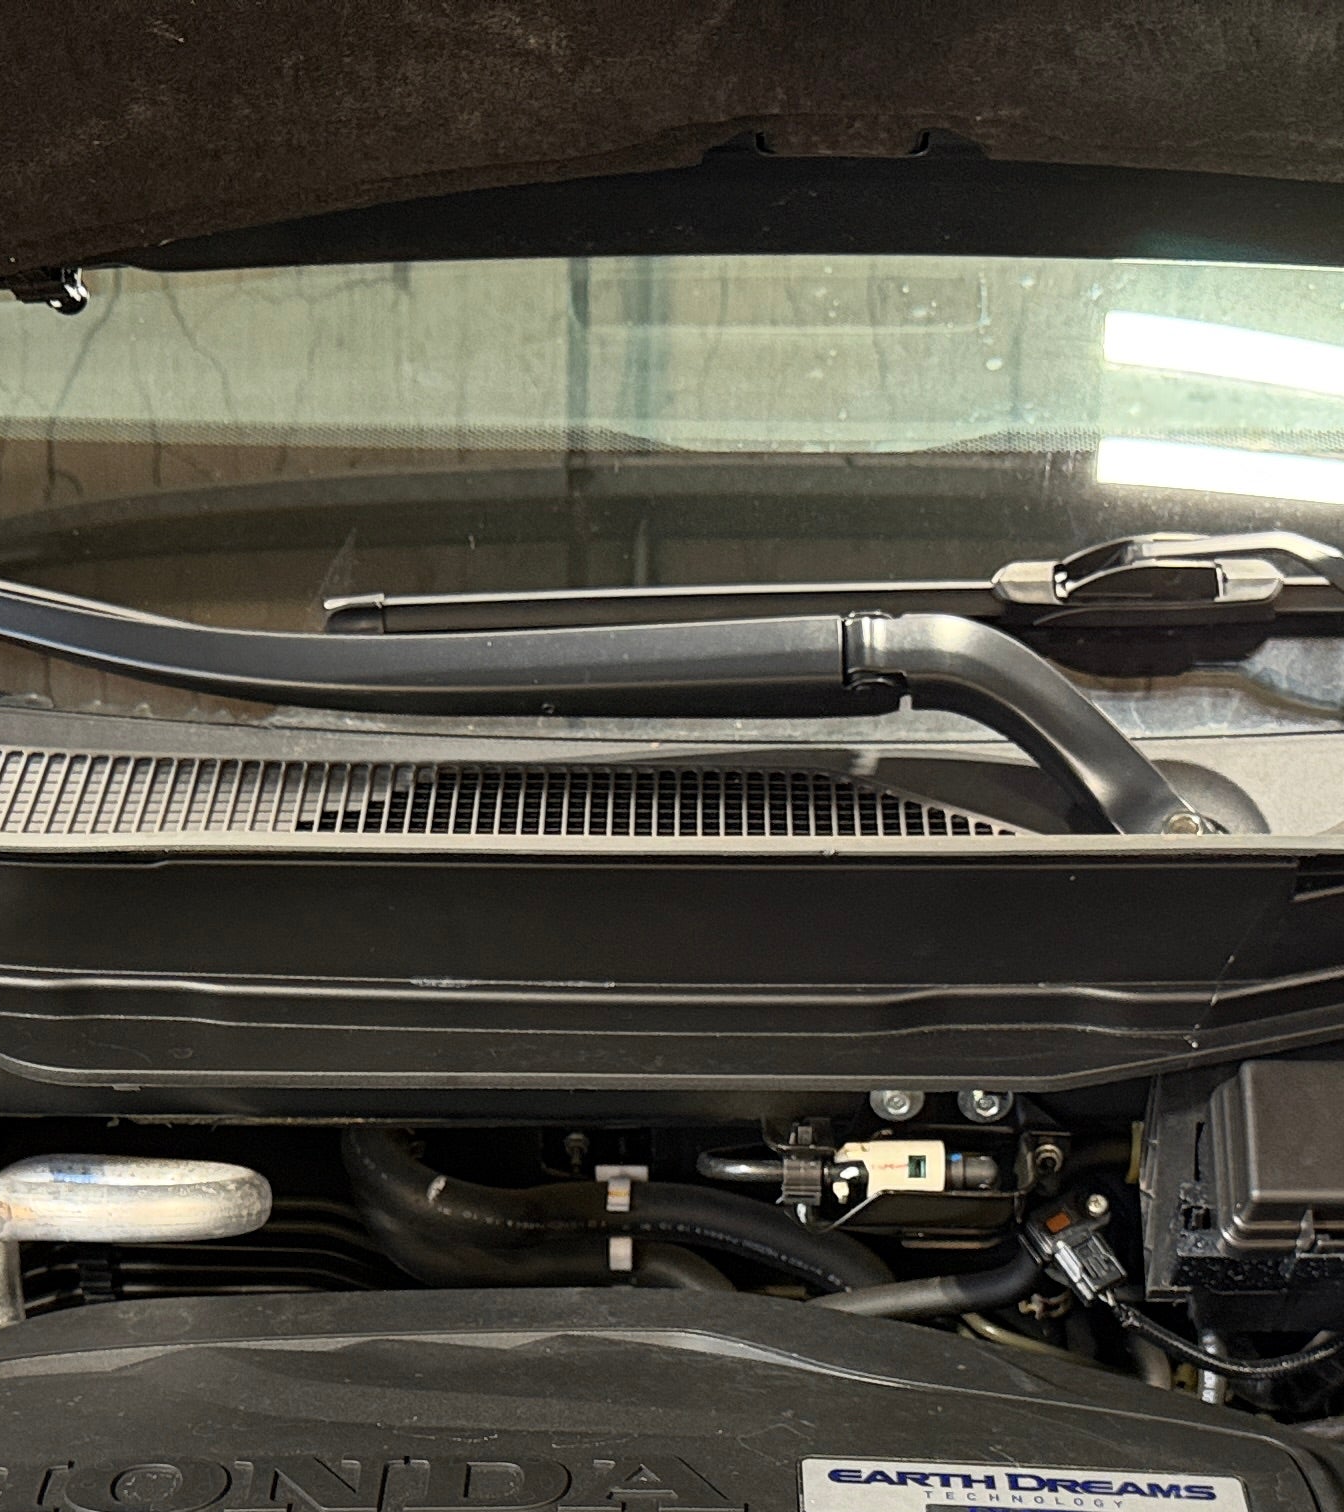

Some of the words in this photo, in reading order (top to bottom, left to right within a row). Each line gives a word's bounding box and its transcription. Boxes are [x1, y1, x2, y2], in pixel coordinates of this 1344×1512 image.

[827, 1468, 997, 1491] EARTH
[1005, 1472, 1217, 1501] DREAMS
[923, 1490, 1124, 1508] TECHNOLOGY
